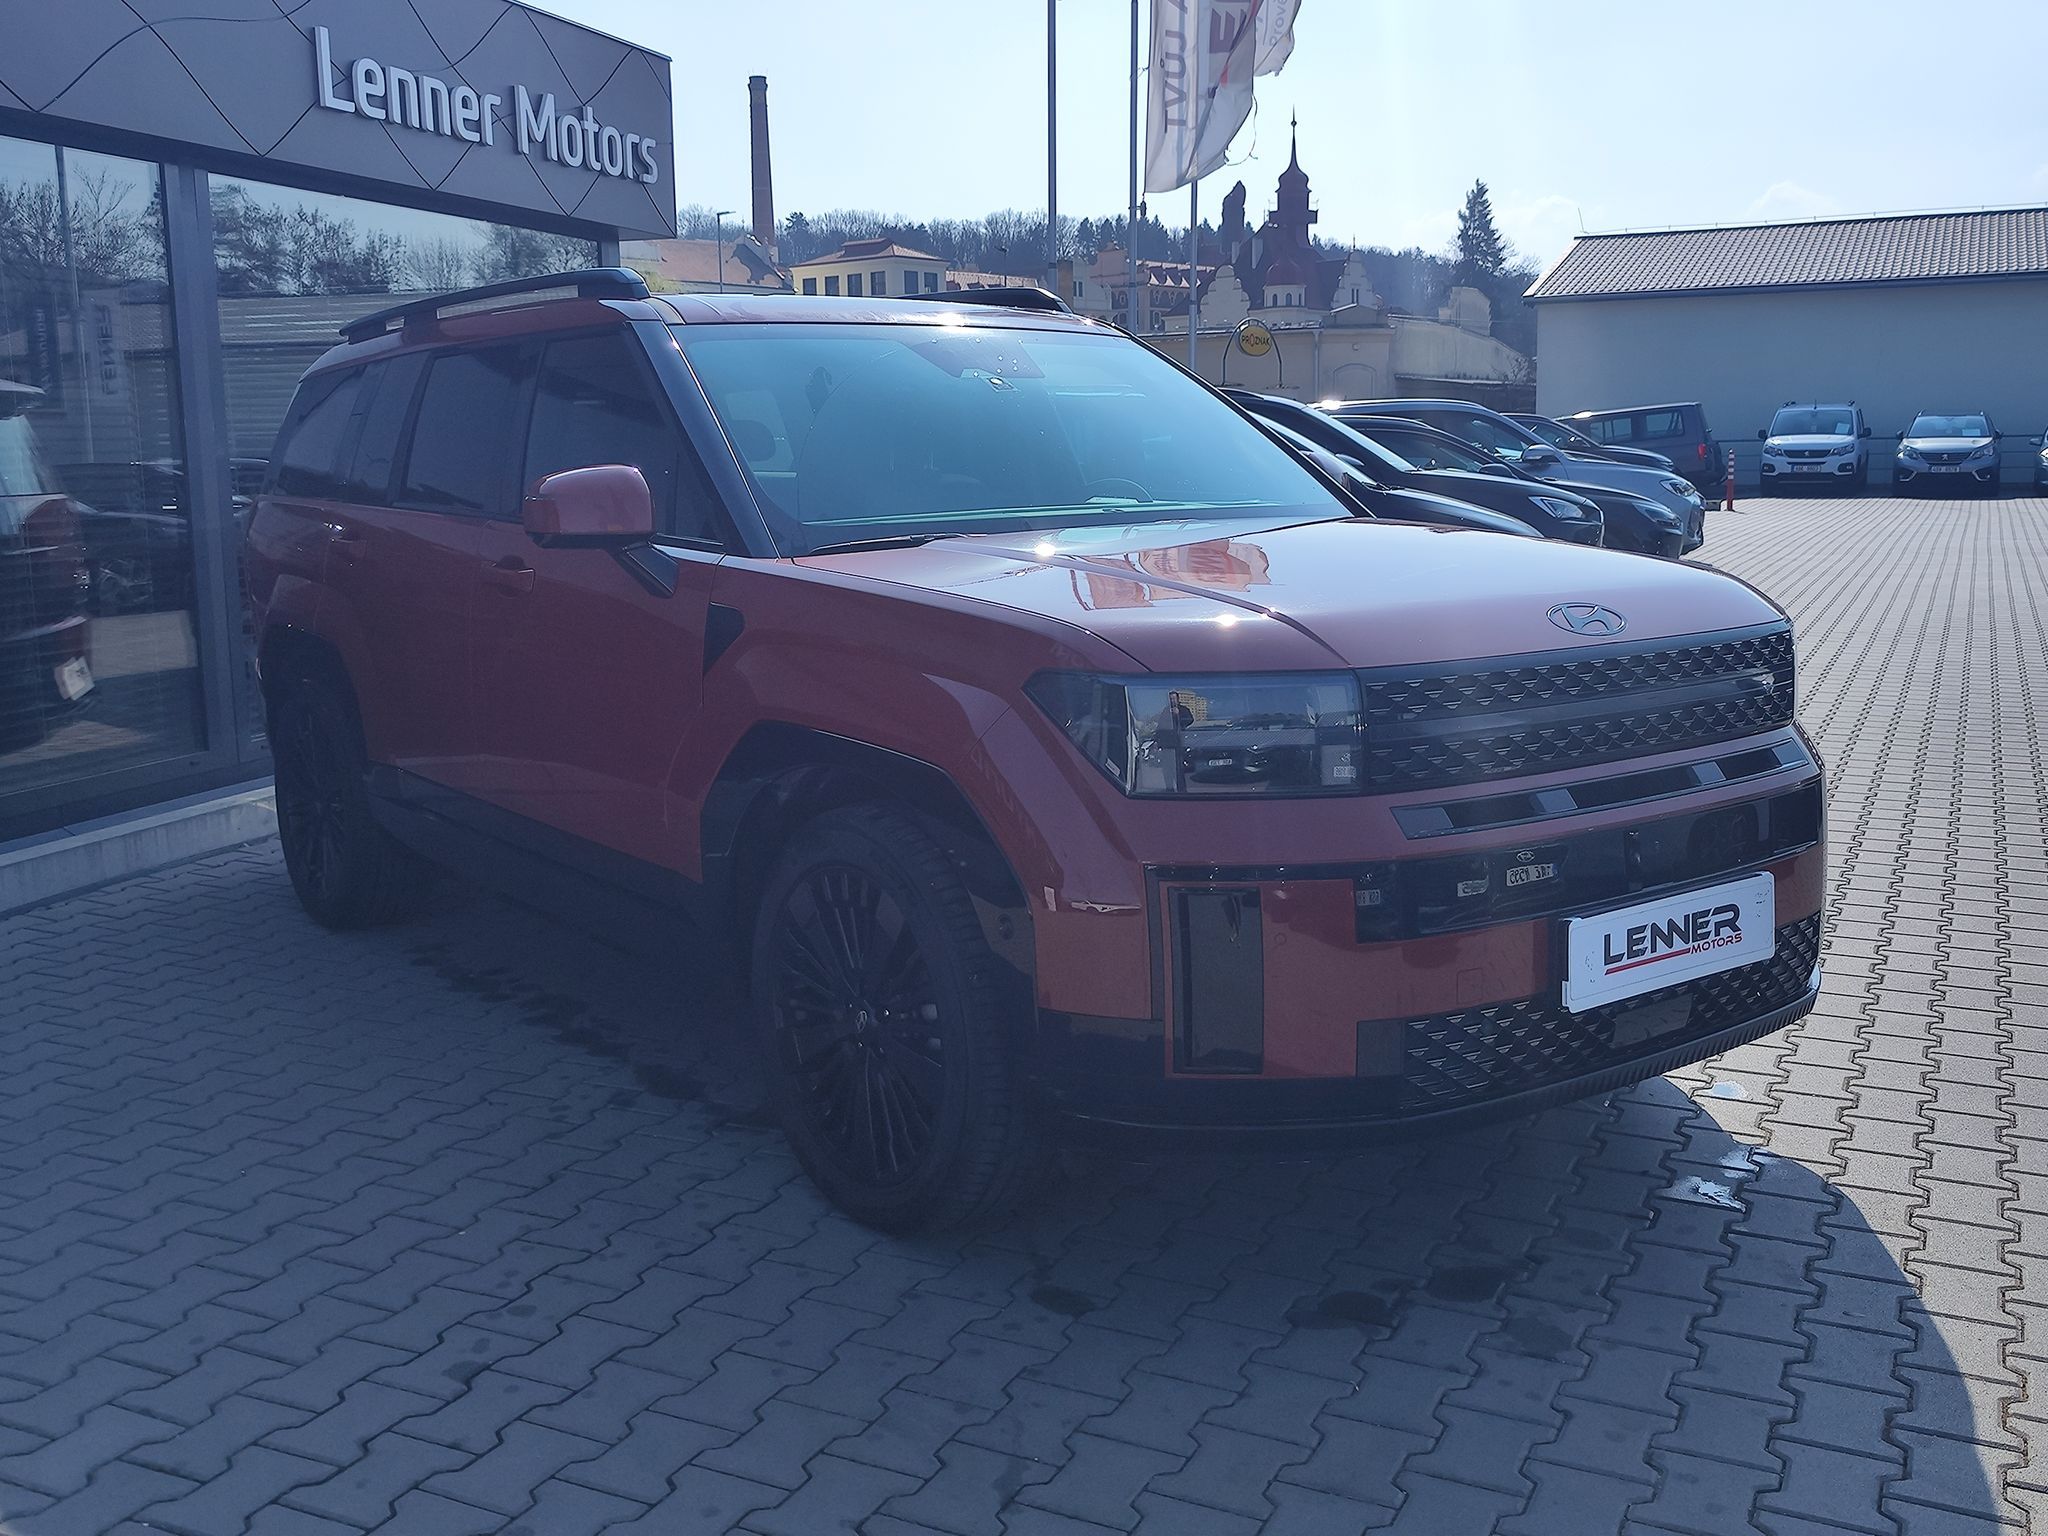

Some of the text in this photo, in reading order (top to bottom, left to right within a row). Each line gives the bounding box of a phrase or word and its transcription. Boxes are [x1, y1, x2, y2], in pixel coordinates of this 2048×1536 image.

[313, 25, 659, 184] Lenner Motors
[1603, 903, 1742, 966] LENNER
[1691, 933, 1742, 955] MOTORS
